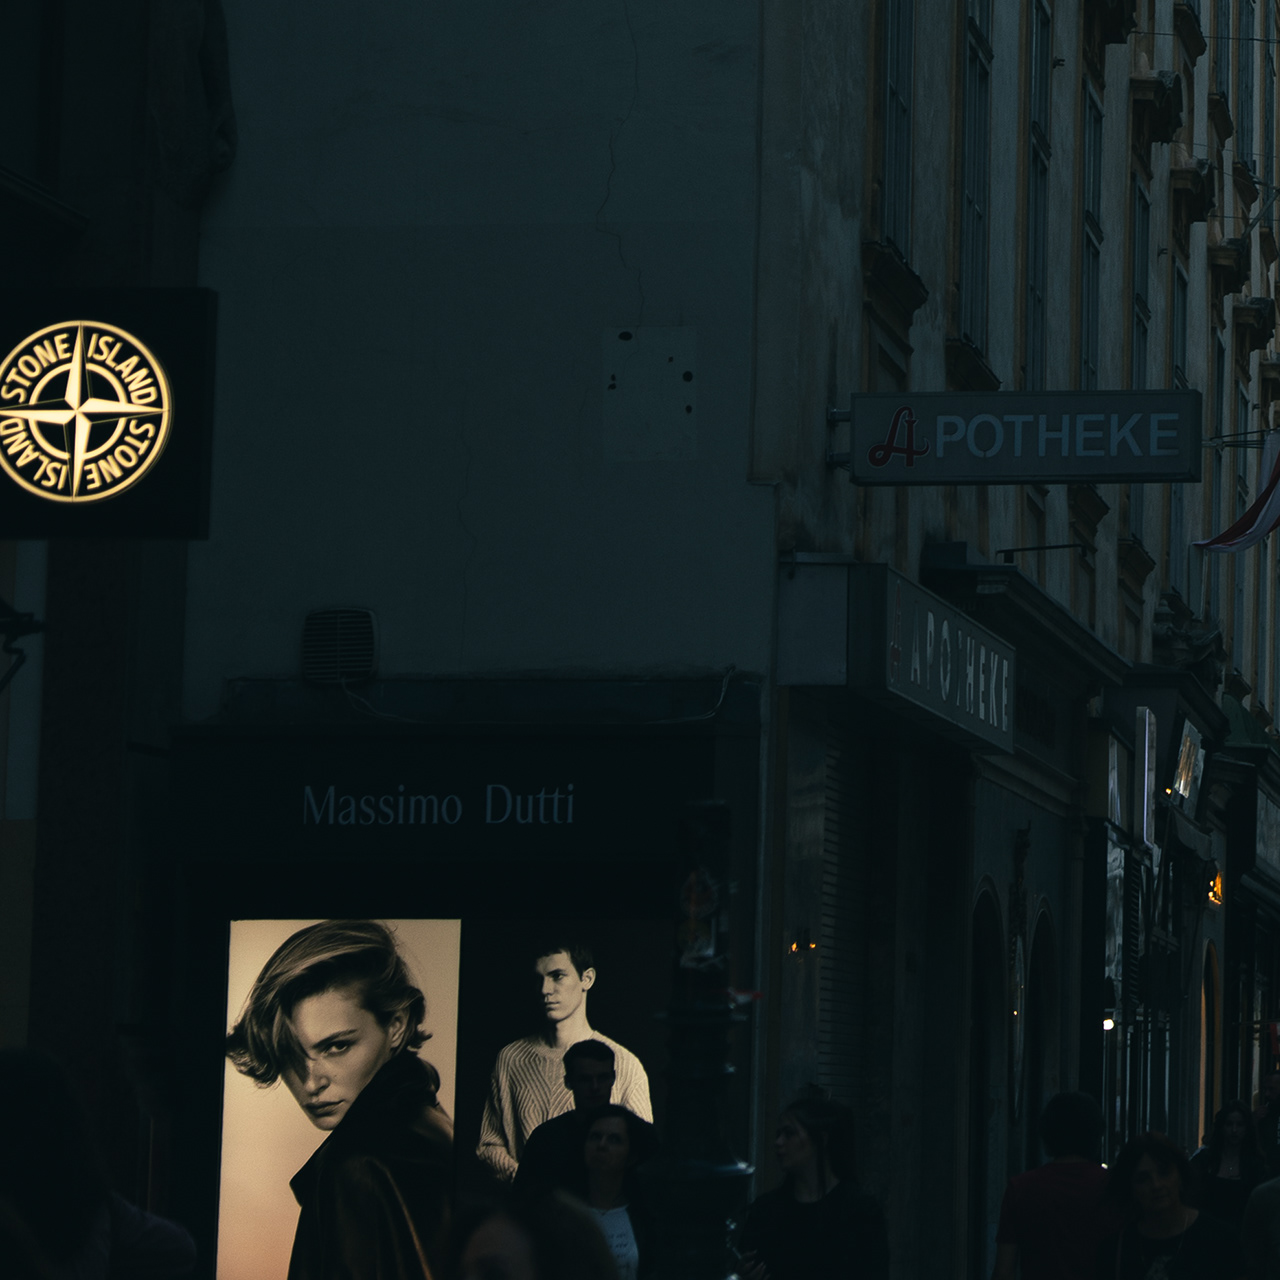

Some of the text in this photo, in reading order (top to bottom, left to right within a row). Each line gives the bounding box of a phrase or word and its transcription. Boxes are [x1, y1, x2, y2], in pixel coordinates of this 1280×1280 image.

[1, 332, 159, 405] STONE ISLAND
[303, 783, 575, 825] Massimo Dutti
